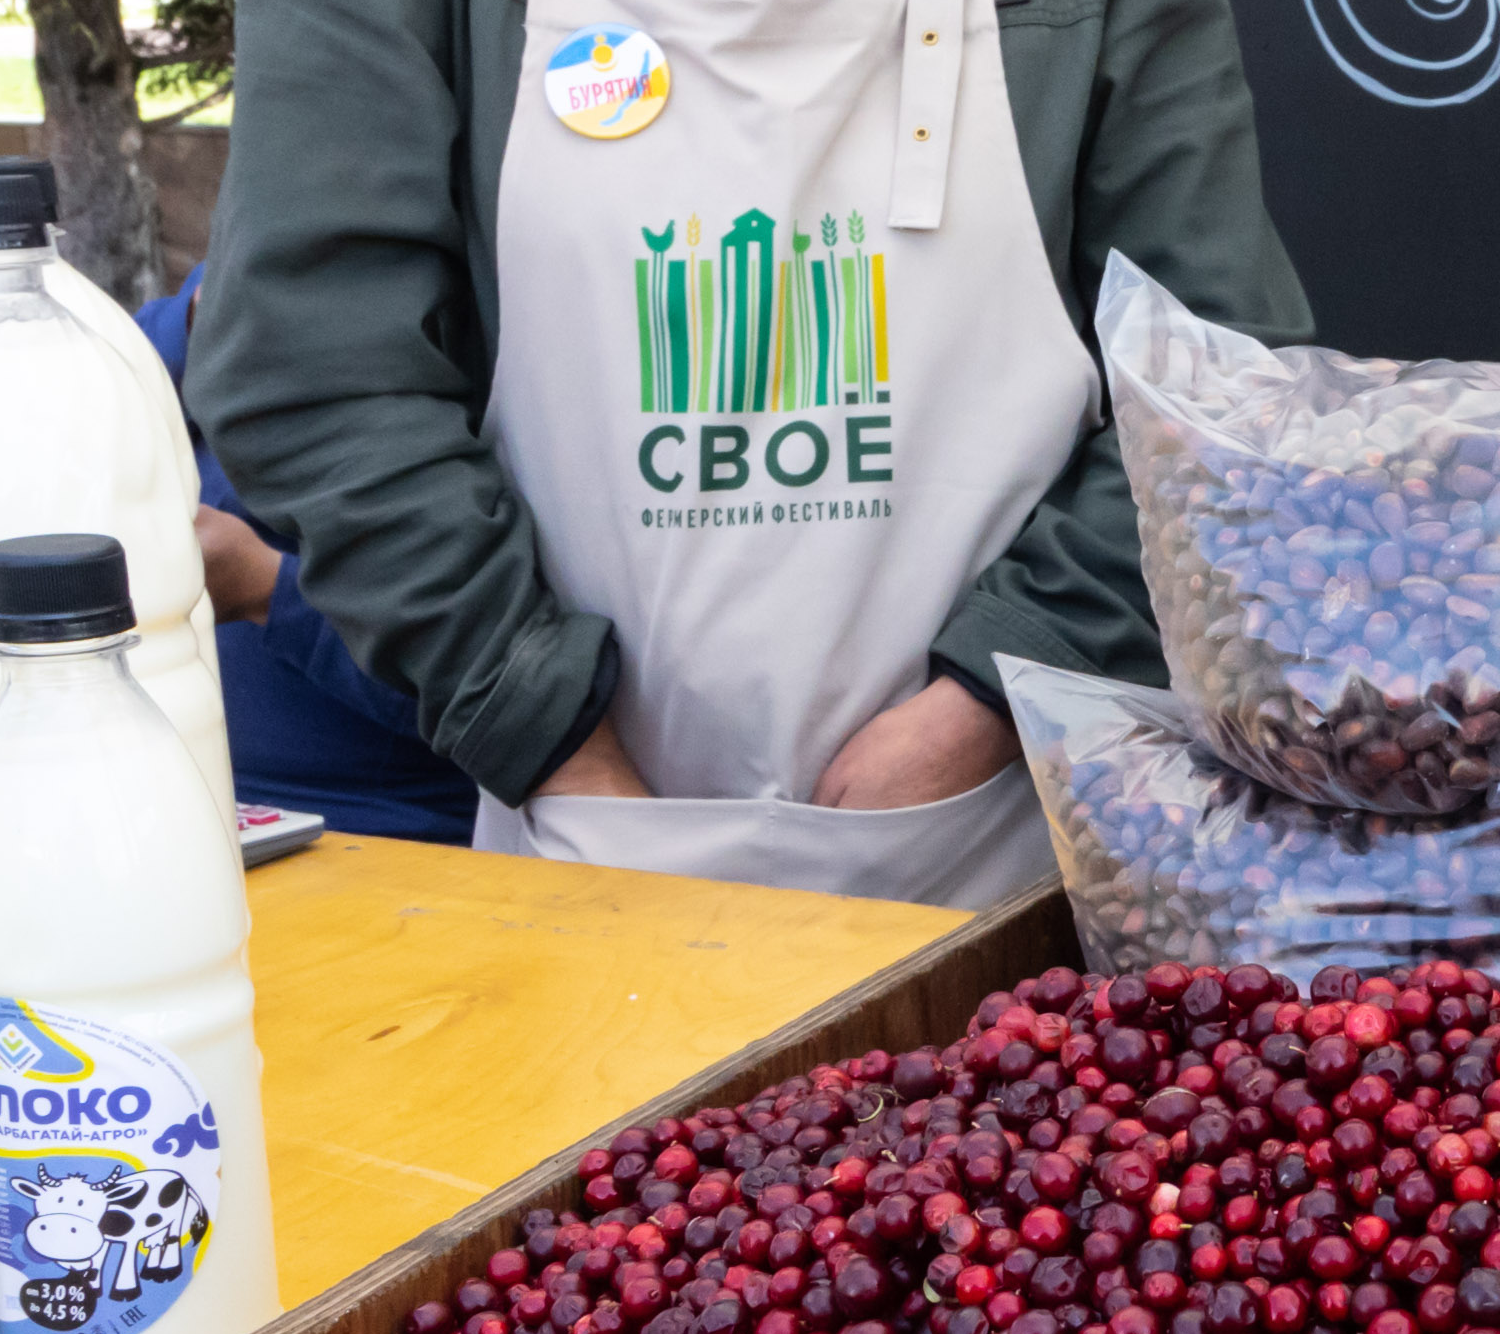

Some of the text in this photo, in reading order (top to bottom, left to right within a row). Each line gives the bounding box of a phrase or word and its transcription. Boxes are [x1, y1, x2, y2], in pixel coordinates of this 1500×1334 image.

[567, 73, 653, 111] БУРЯТИЯ
[641, 499, 893, 529] ФЕРМЕРСКИЙ ФЕСТИВАЛЬ
[41, 1283, 66, 1301] 3,0
[68, 1285, 85, 1303] %
[43, 1303, 67, 1321] 4,5
[70, 1305, 87, 1321] %
